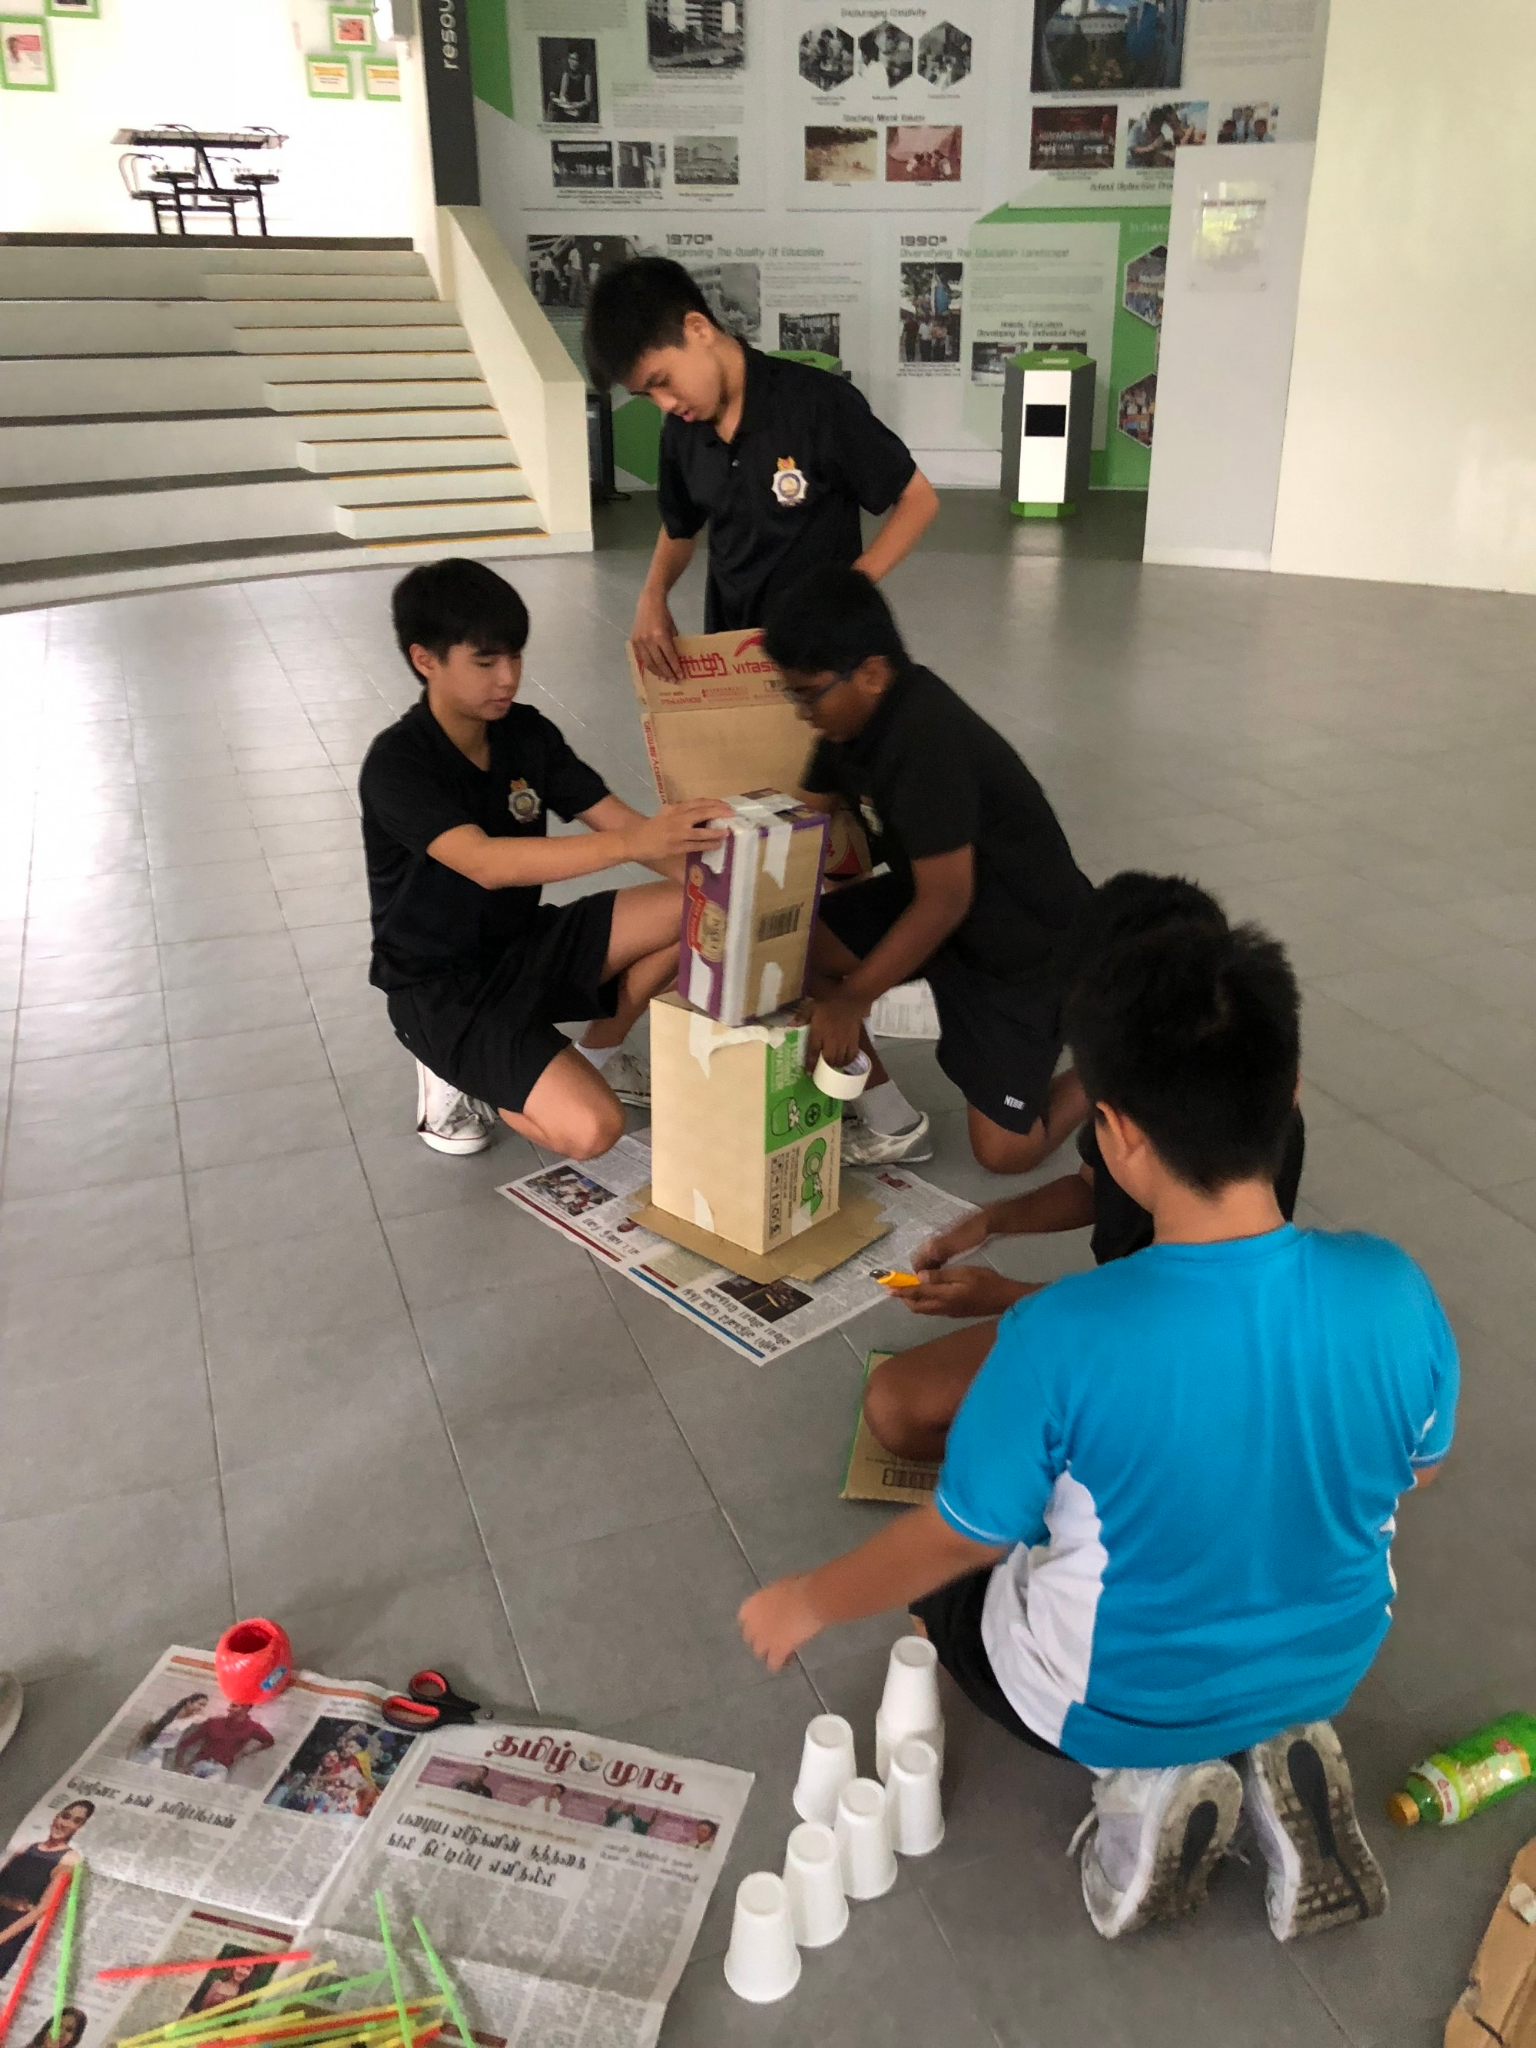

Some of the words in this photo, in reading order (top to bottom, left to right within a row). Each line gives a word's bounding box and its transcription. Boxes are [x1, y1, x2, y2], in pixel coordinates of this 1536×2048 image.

[667, 248, 714, 259] Improving
[718, 247, 732, 257] The
[735, 247, 765, 259] Quality
[781, 247, 825, 257] Education
[900, 249, 952, 260] Diversifying
[957, 249, 971, 258] The
[975, 249, 1018, 258] Education
[1021, 249, 1070, 259] Landscape
[484, 1735, 577, 1774] தமிழ்
[602, 1759, 686, 1795] முரசு
